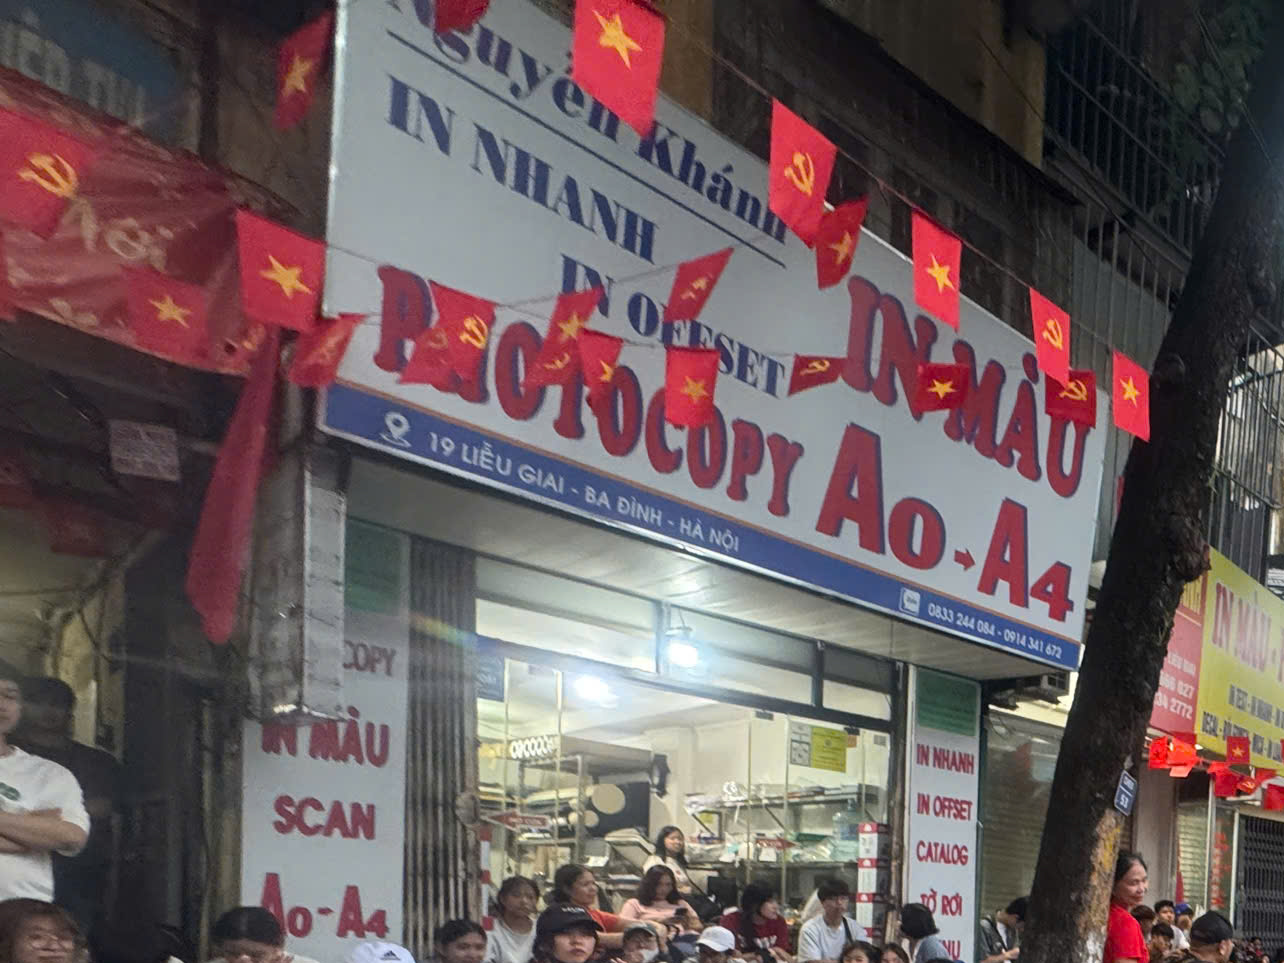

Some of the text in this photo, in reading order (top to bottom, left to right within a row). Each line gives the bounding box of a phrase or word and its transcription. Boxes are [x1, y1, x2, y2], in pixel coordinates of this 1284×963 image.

[385, 74, 659, 264] IN NHANH
[634, 120, 786, 244] Khánh
[561, 253, 616, 318] IN
[840, 274, 938, 422] IN
[429, 431, 455, 457] 19
[461, 440, 512, 476] LIỄU
[517, 463, 565, 495] GIAI
[584, 485, 611, 511] BA
[617, 496, 662, 527] ĐÌNH
[679, 517, 704, 543] HÀ
[709, 526, 739, 553] NỘI
[977, 497, 1074, 622] A4
[1212, 582, 1234, 651] IN
[262, 705, 390, 768] IN MÀU
[916, 743, 975, 775] IN NHANH
[273, 794, 376, 840] SCAN
[916, 792, 973, 821] IN OFFSET
[916, 840, 969, 866] CATALOG
[336, 884, 390, 939] A4
